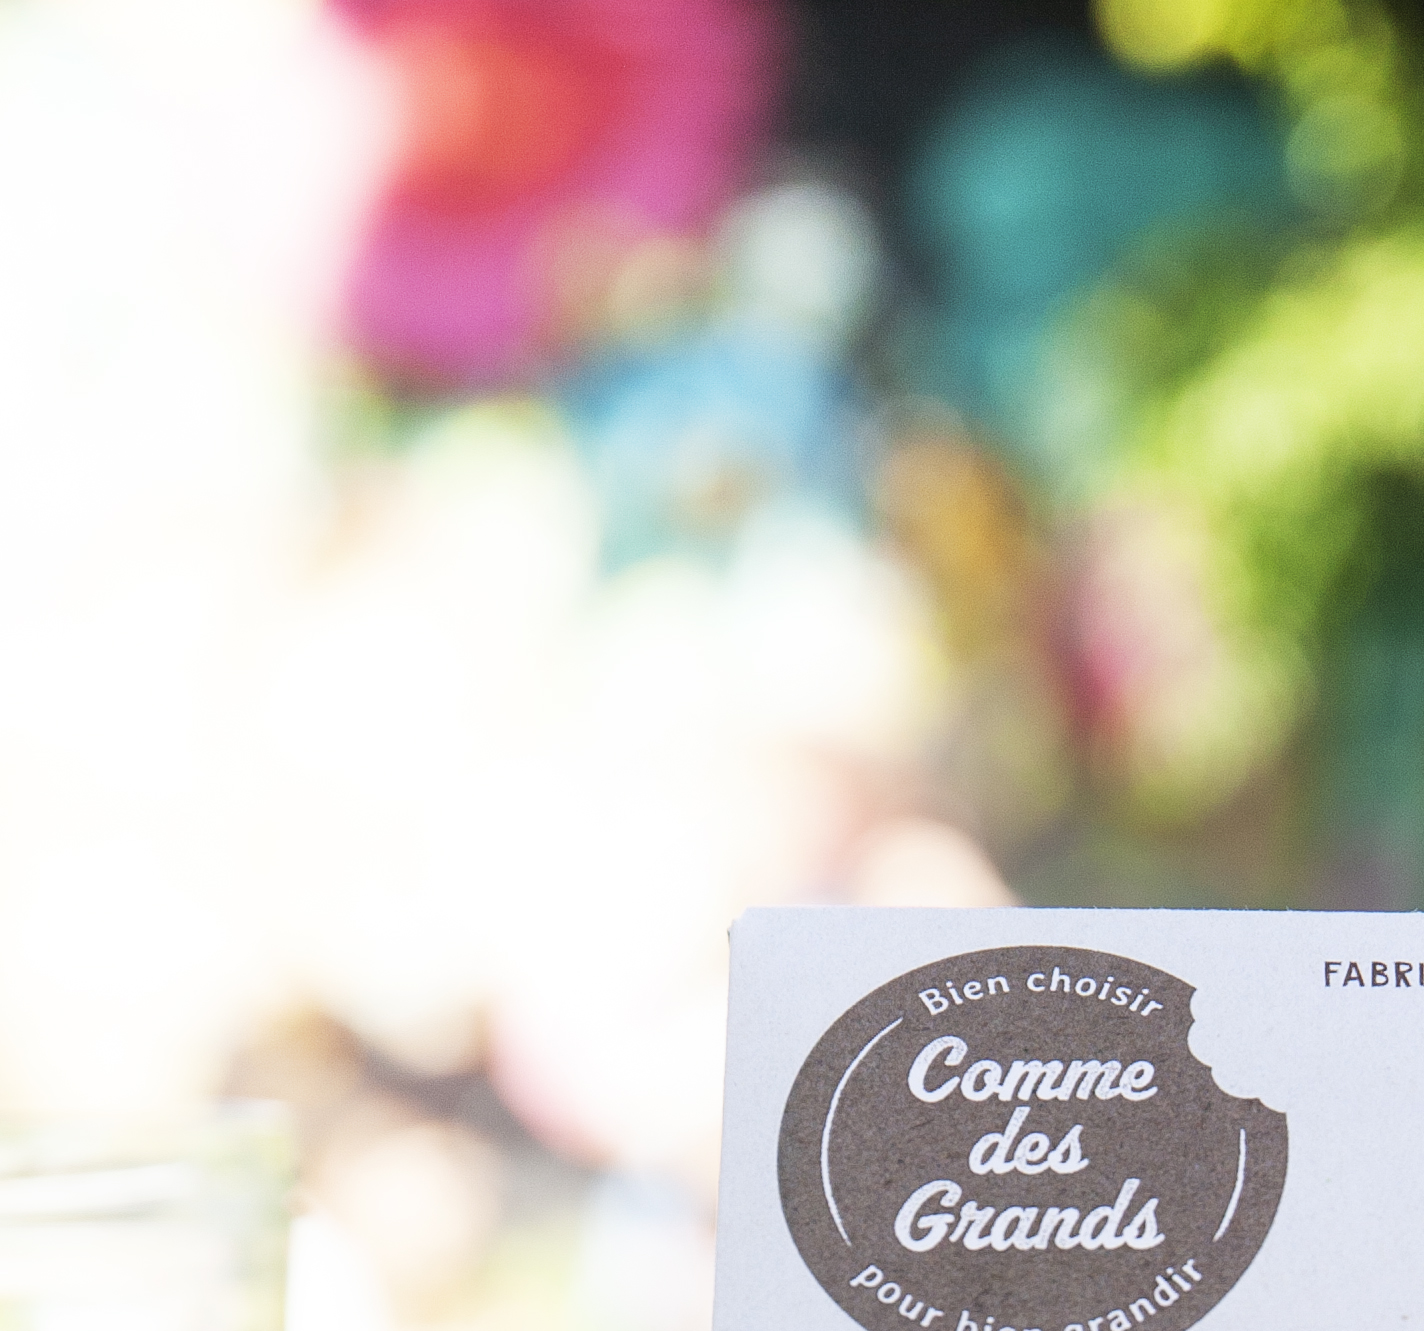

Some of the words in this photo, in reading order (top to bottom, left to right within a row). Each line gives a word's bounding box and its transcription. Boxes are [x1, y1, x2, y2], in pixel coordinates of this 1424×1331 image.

[919, 971, 1009, 1016] Bien
[1026, 967, 1163, 1019] choisir
[908, 1035, 1158, 1102] Comme
[968, 1107, 1088, 1174] des
[894, 1178, 1165, 1251] Grands
[850, 1264, 943, 1328] pour
